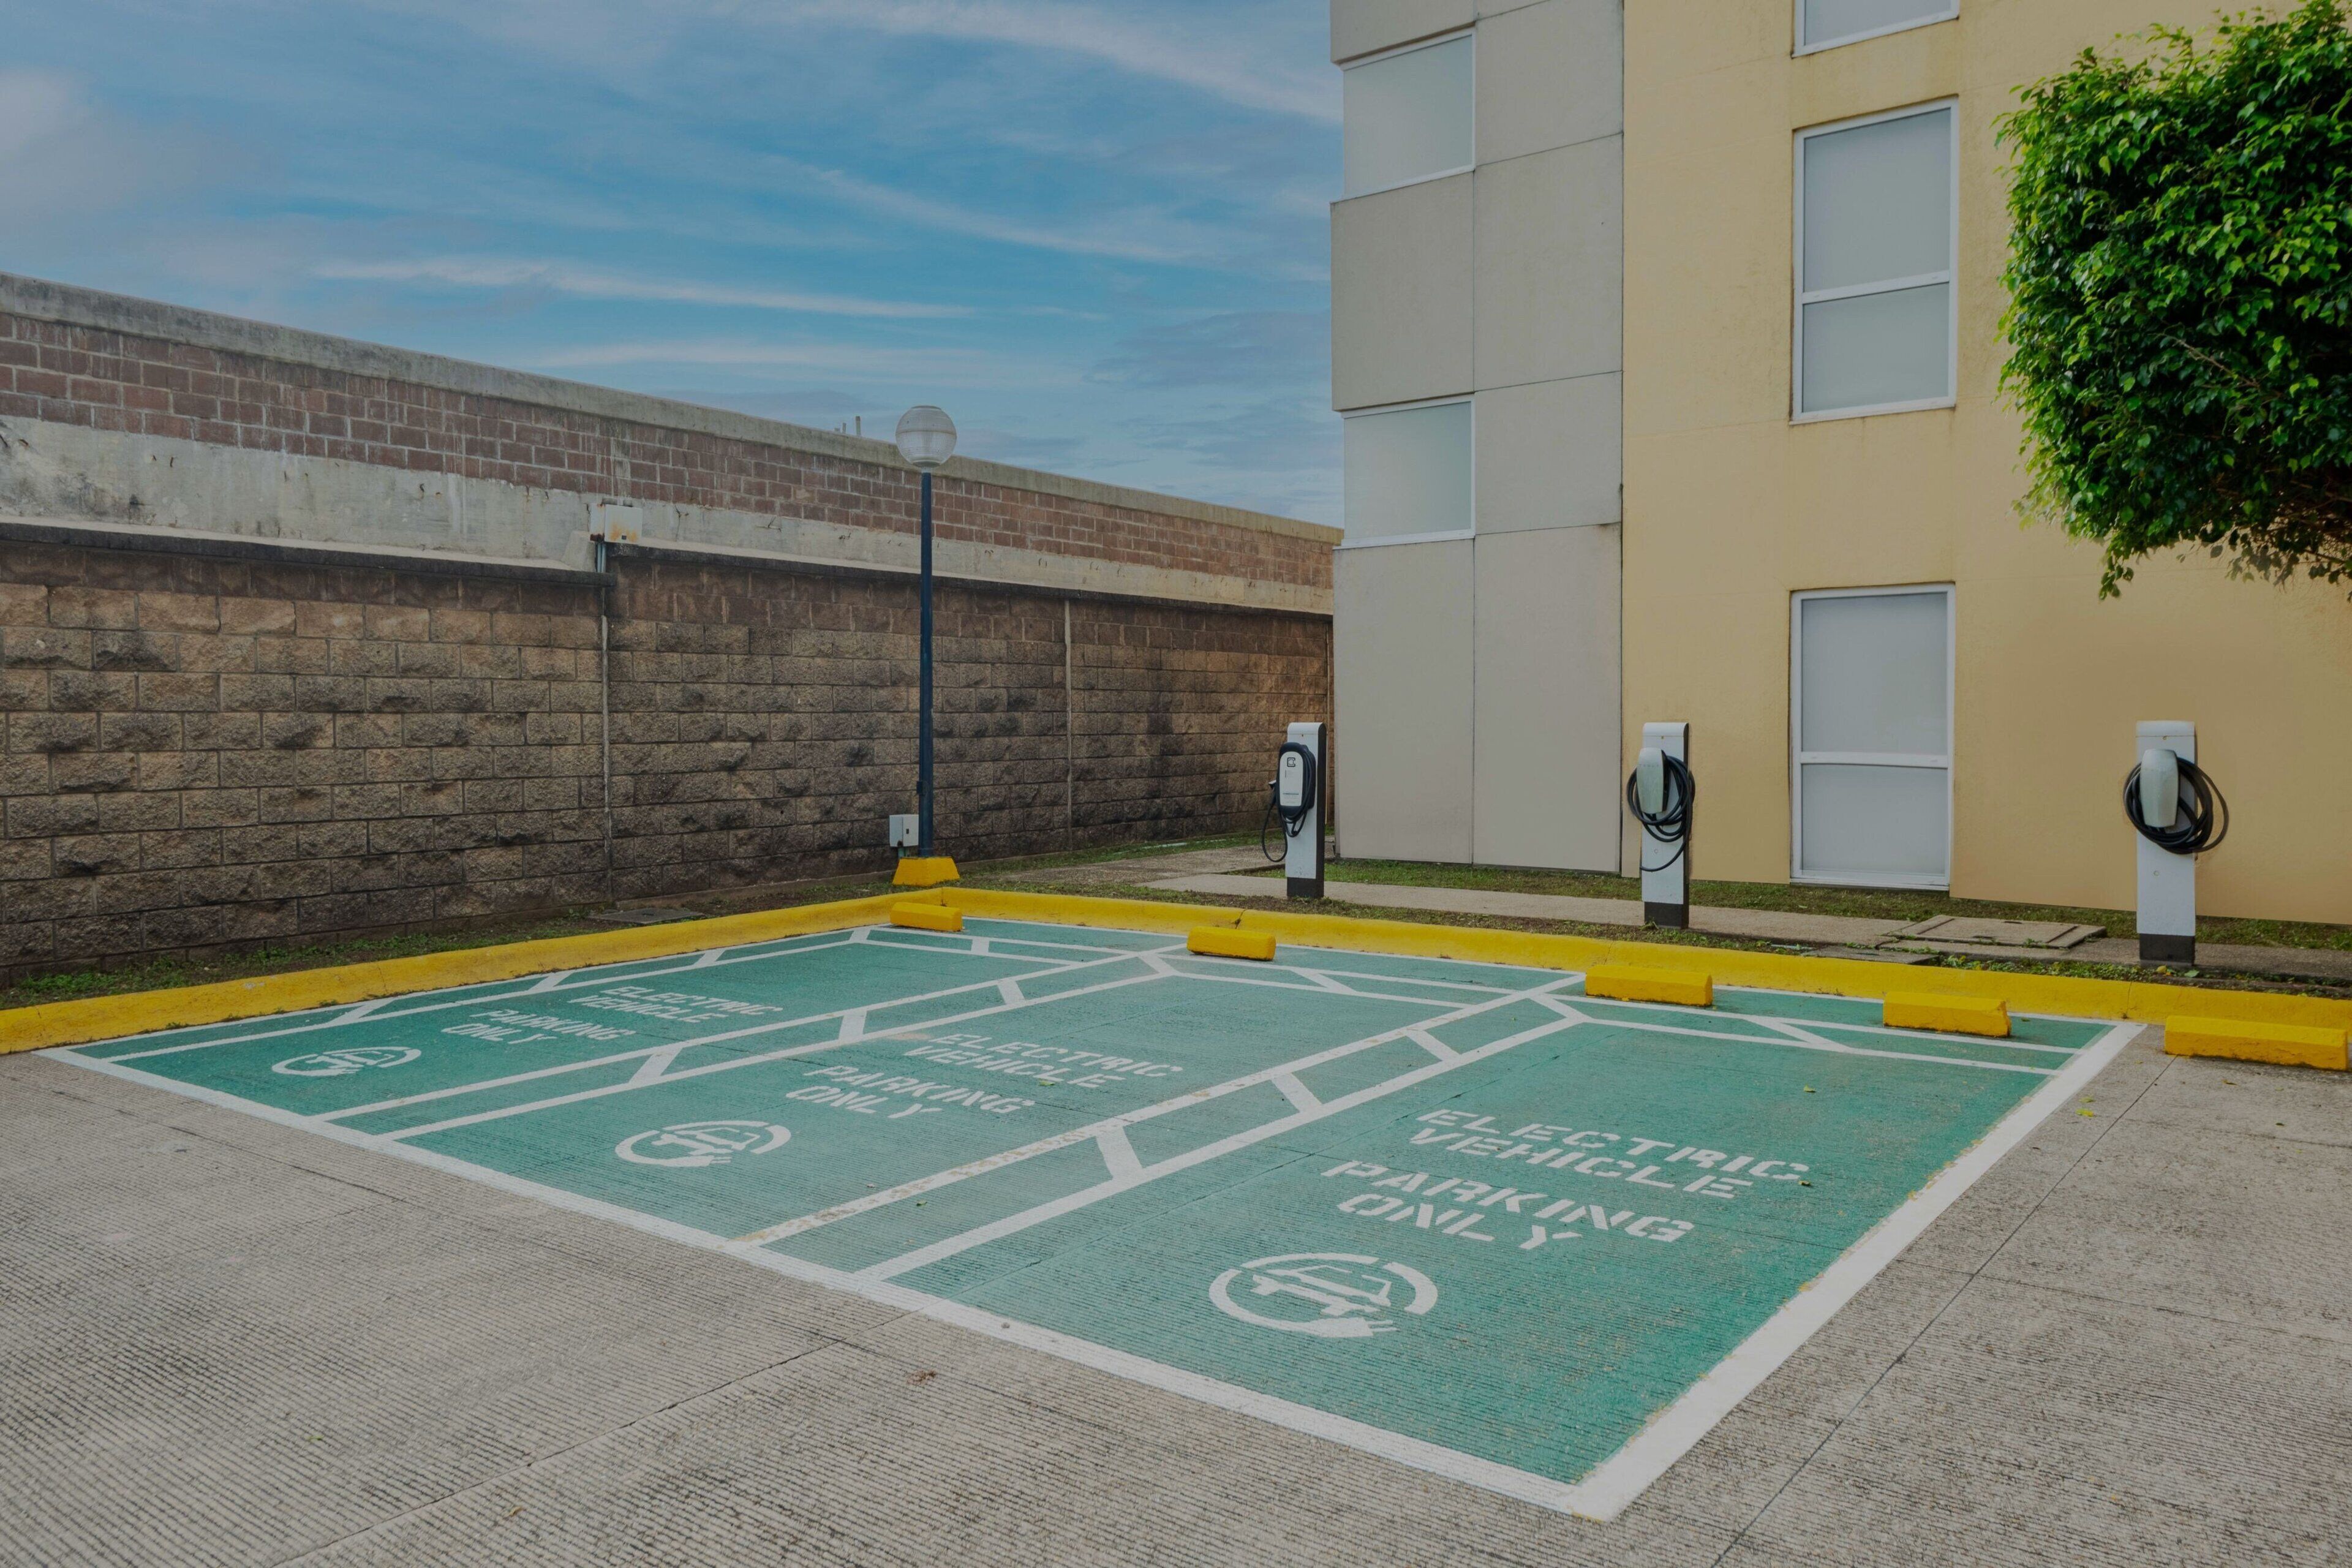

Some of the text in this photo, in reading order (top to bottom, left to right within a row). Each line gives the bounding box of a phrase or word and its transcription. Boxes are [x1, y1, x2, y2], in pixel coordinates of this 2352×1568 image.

[567, 995, 730, 1023] VEHICLE
[600, 986, 783, 1016] ELECTRIC
[441, 1023, 557, 1044] ONLY
[470, 1009, 636, 1041] PARKING
[903, 1045, 1126, 1088] VEHICLE
[929, 1033, 1183, 1077] ELECTRIC
[785, 1085, 943, 1119] ONLY
[804, 1065, 1036, 1114] PARKING
[1409, 1128, 1754, 1199] VEHICLE
[1415, 1109, 1811, 1180] ELECTRIC
[1320, 1160, 1695, 1243] PARKING
[1336, 1193, 1583, 1250] ONLY
